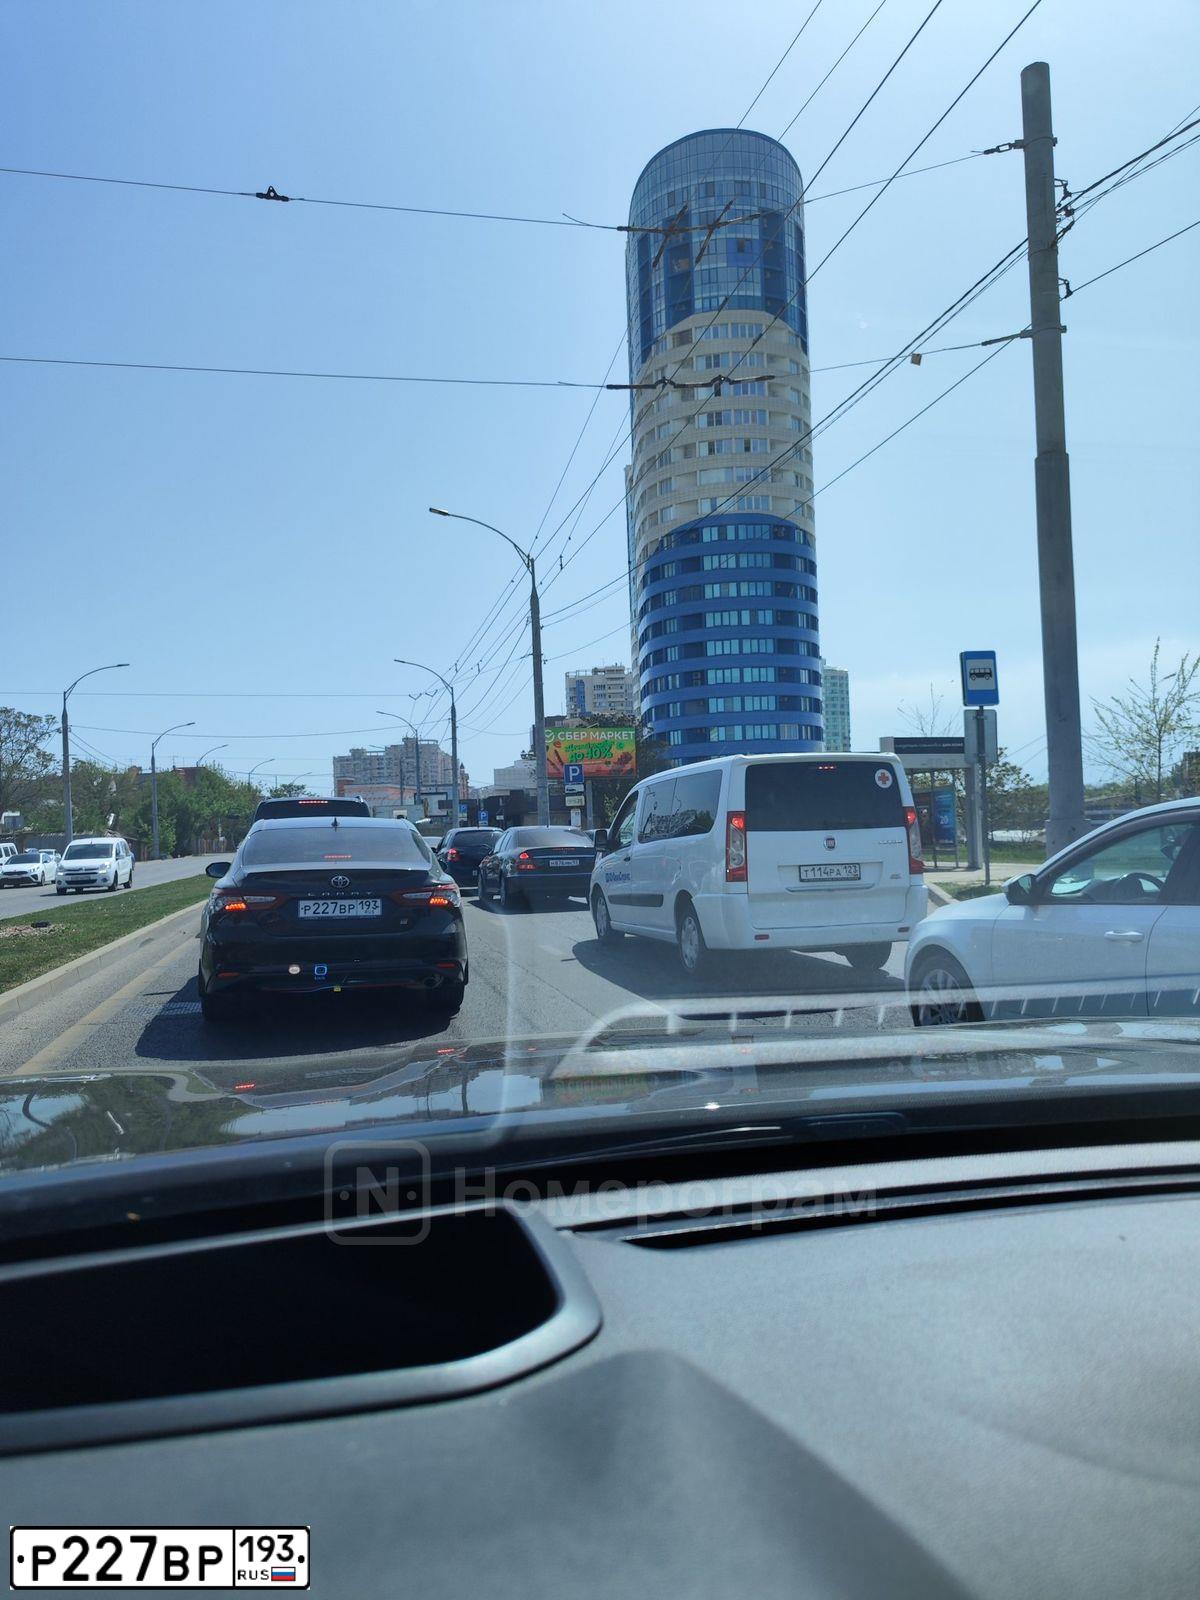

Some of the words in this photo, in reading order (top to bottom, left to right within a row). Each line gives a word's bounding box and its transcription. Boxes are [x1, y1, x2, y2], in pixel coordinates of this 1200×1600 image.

[557, 731, 588, 741] СБЕР
[590, 731, 636, 741] МАРКЕТ
[303, 902, 355, 915] Р227ВР
[358, 901, 378, 910] 193
